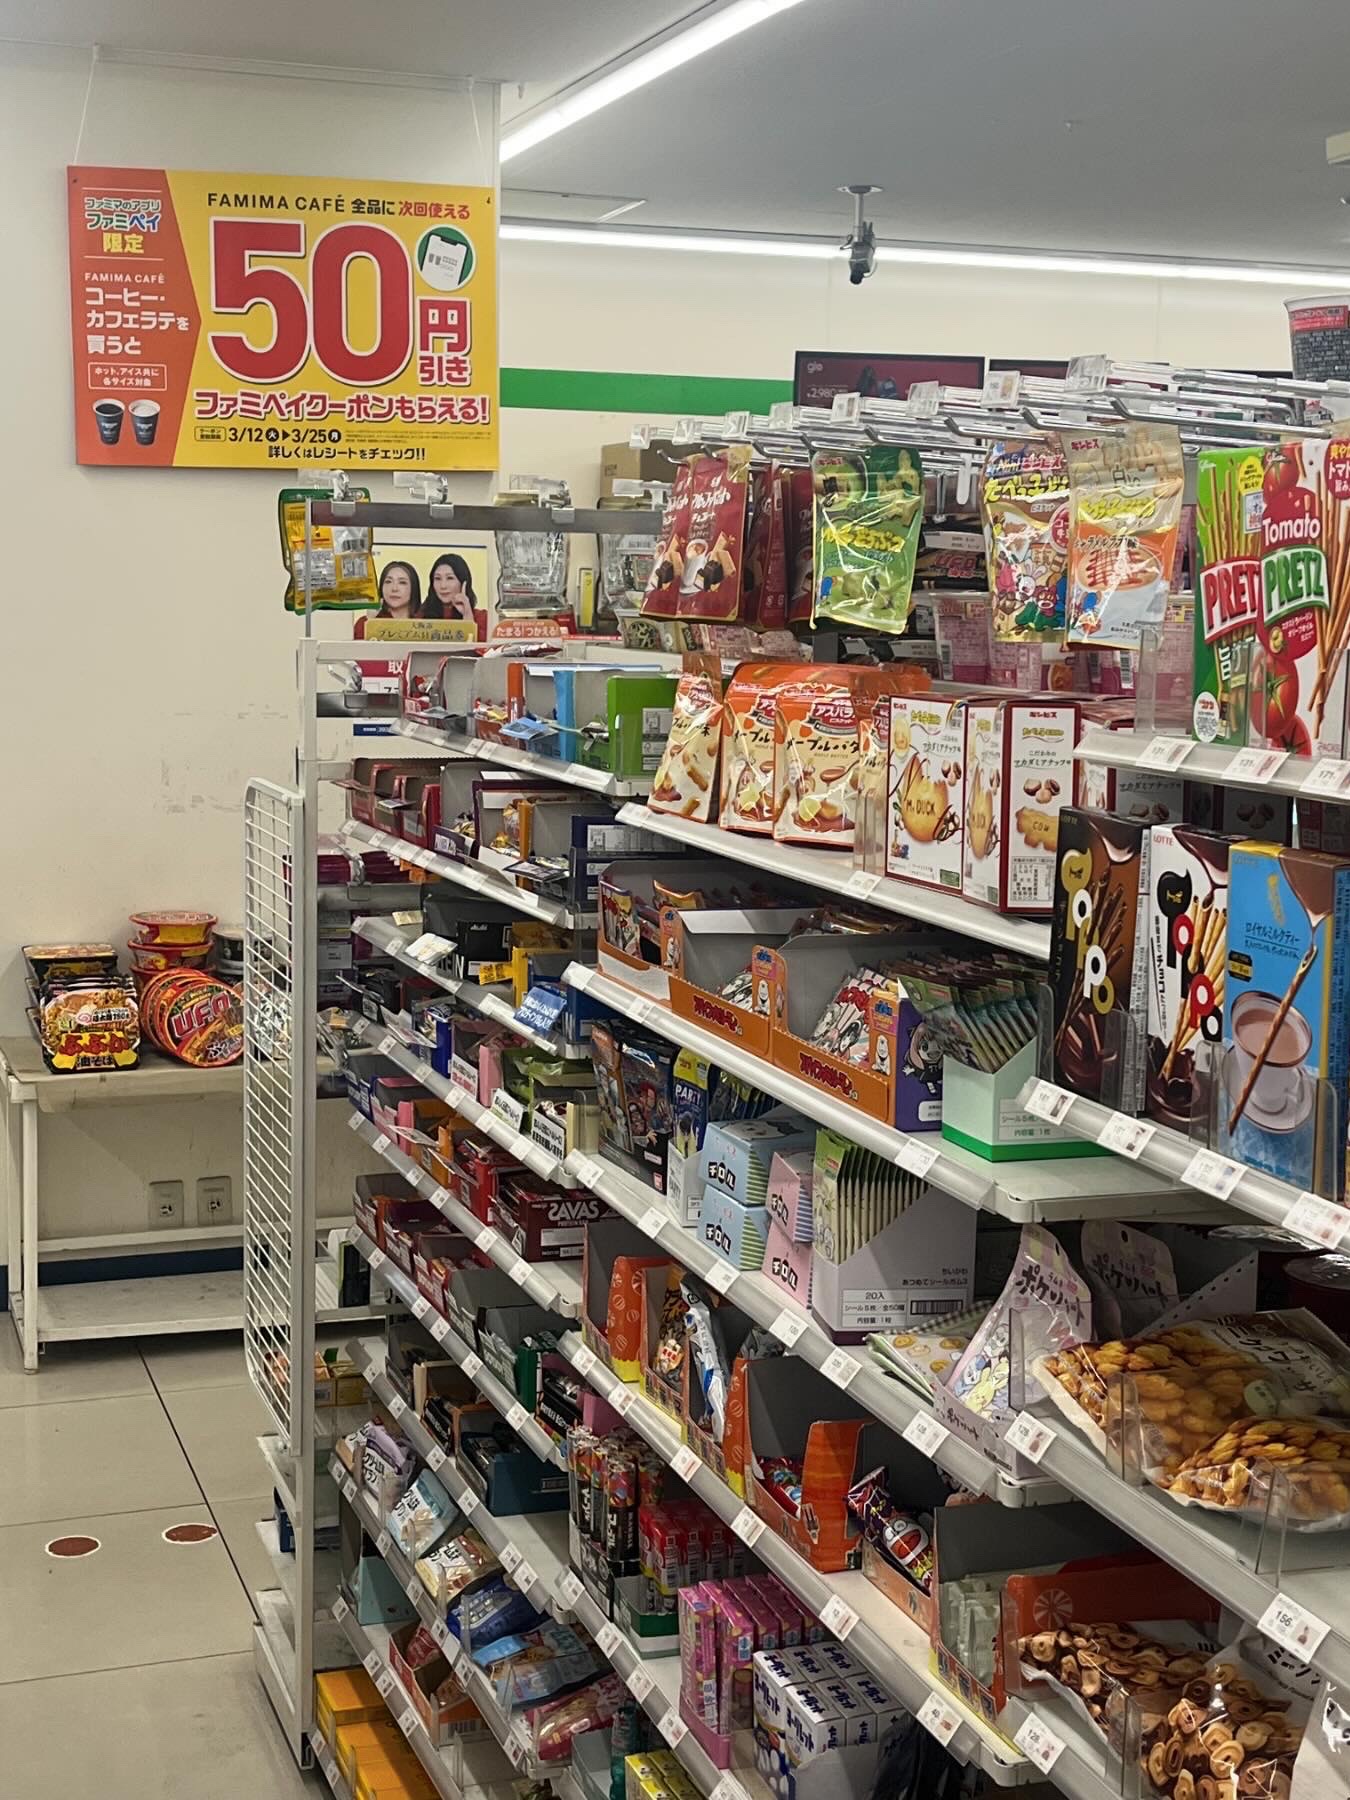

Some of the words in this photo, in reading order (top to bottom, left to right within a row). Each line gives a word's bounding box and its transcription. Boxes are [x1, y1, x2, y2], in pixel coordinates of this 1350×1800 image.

[84, 197, 161, 211] ファミマのアプリ
[207, 192, 289, 210] FAMIMA
[295, 194, 345, 212] CAFÉ
[350, 198, 396, 216] 全品に
[398, 200, 471, 220] 次回使える
[86, 212, 162, 232] ファミペイ
[102, 231, 145, 254] 限定
[85, 272, 132, 283] FAMIMA
[134, 273, 165, 284] CAFÉ
[207, 216, 414, 386] 50
[86, 310, 190, 332] カフェラテを
[87, 335, 142, 356] 買うと
[418, 355, 470, 385] 引き
[1262, 512, 1321, 547] Tomato
[1203, 563, 1260, 632] PRET
[1263, 551, 1325, 616] PRETZ
[1153, 834, 1174, 847] LOTTE
[708, 1161, 737, 1191] チロル
[548, 1200, 601, 1222] SAVAS
[771, 1193, 790, 1227] チロル
[705, 1223, 732, 1256] チロル
[771, 1257, 799, 1292] チロル
[1276, 1611, 1293, 1627] 156
